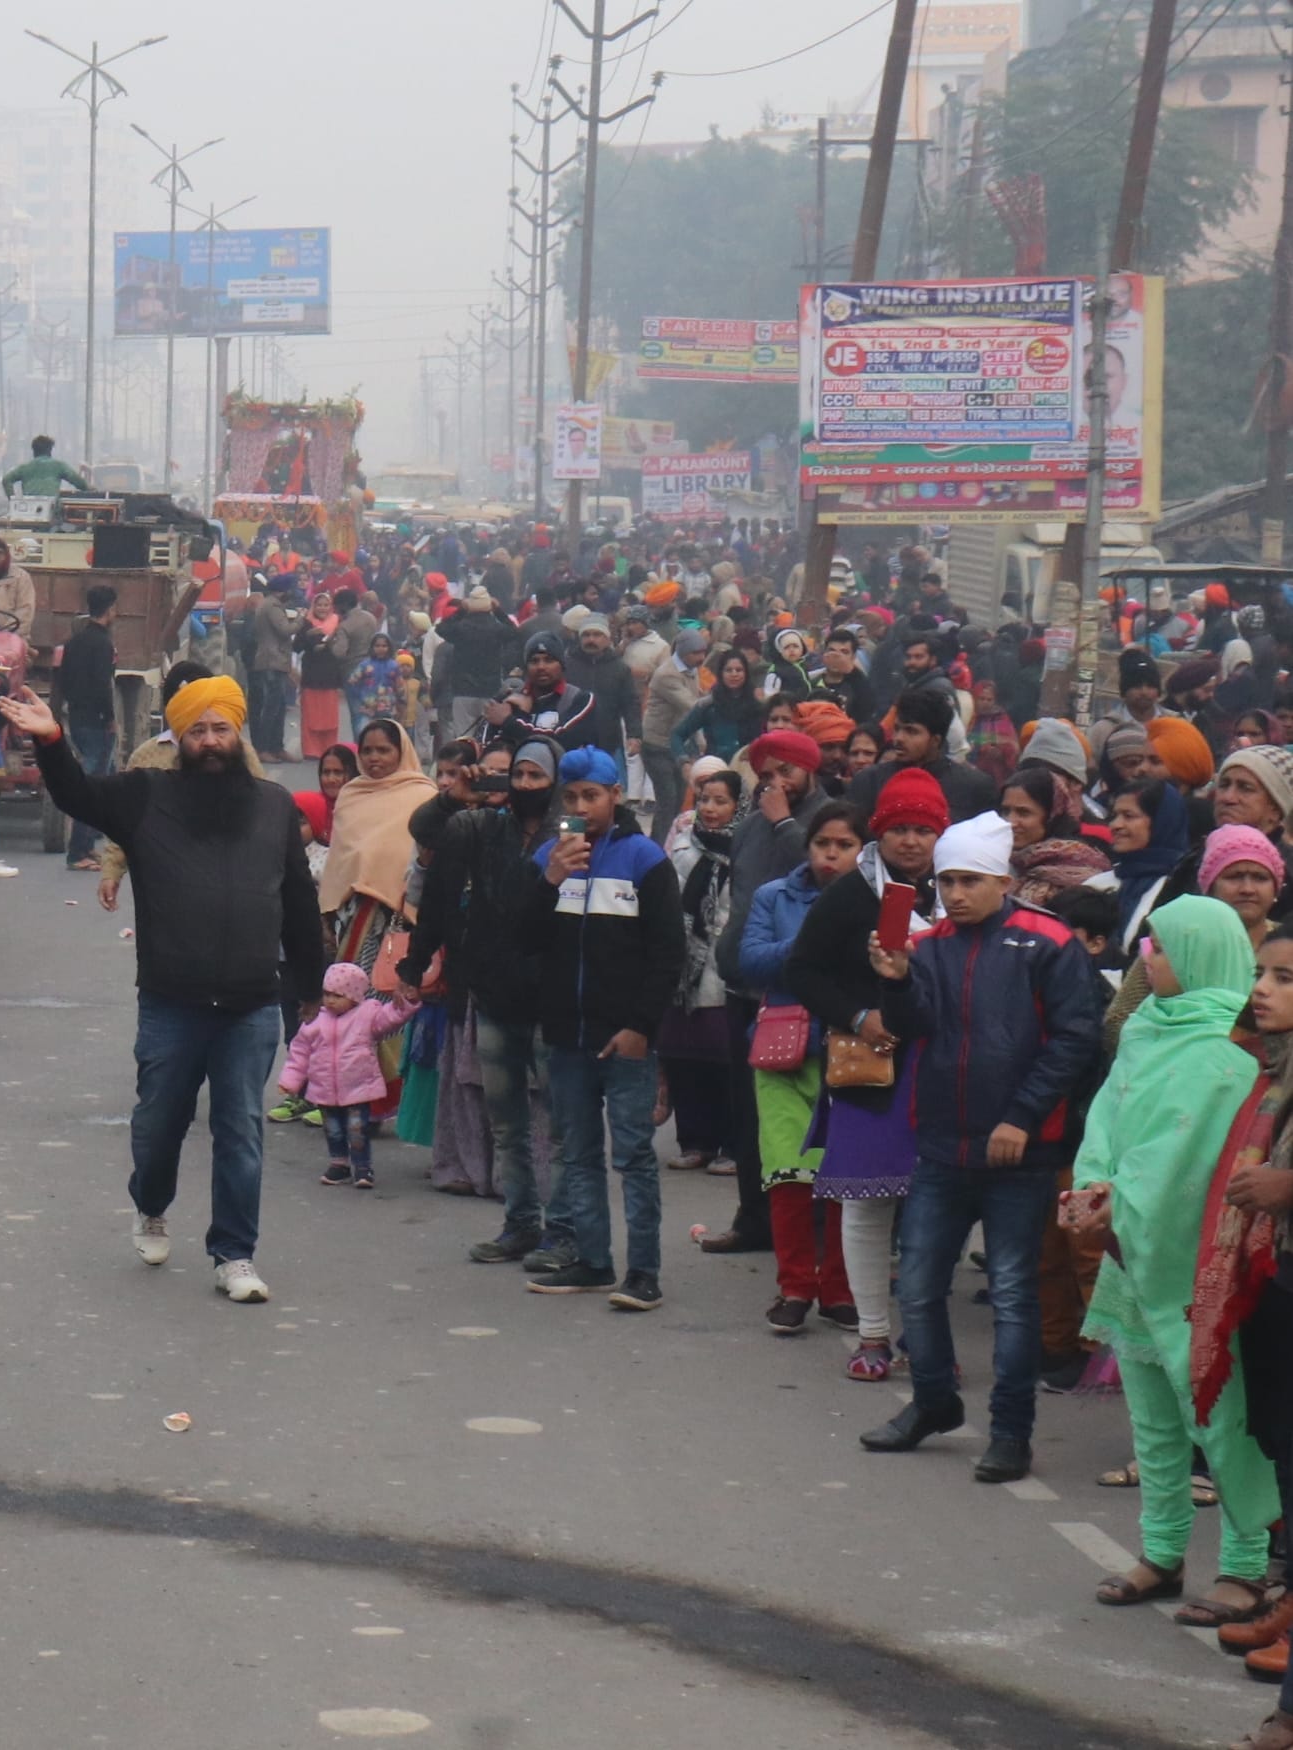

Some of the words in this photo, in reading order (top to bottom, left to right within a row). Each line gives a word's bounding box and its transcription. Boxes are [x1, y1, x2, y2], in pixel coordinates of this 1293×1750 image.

[860, 287, 929, 305] WING
[936, 284, 1071, 303] INSTITUTE
[660, 319, 736, 332] CAREER
[903, 339, 932, 349] 2nd
[938, 340, 949, 349] &
[956, 340, 981, 349] 3rd
[1030, 342, 1044, 357] 3
[828, 346, 858, 367] JE
[866, 352, 890, 363] SSC
[983, 351, 1022, 362] CTET
[984, 365, 1022, 376] TET
[950, 380, 983, 391] REVIT
[990, 379, 1015, 390] DCA
[824, 395, 853, 406] CCC
[967, 394, 992, 405] C++
[659, 457, 750, 470] PARAMOUNT
[662, 474, 749, 493] LIBRARY
[614, 889, 636, 902] FILA
